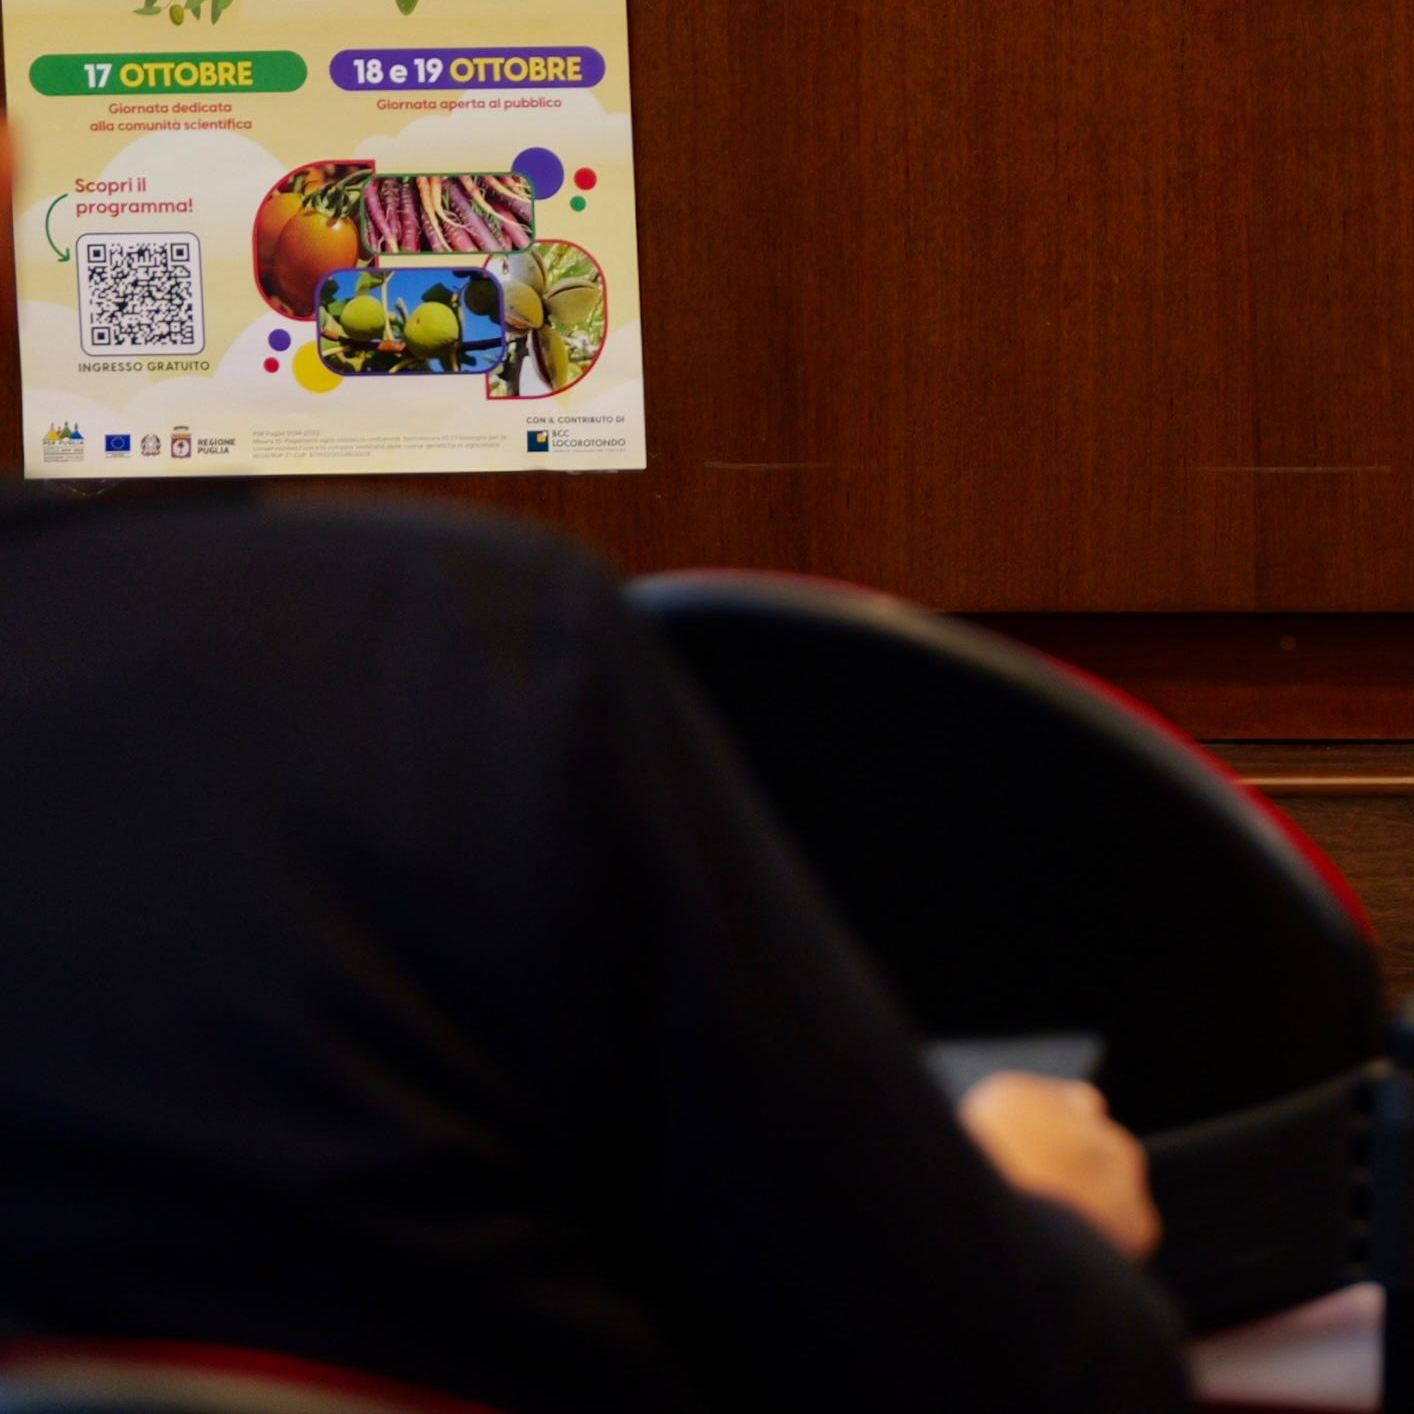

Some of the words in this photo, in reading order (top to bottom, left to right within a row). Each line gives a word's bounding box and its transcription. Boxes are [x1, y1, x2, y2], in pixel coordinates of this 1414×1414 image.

[84, 63, 112, 88] 17
[120, 61, 253, 87] OTTOBRE
[354, 58, 384, 83] 18
[389, 65, 407, 83] e
[414, 58, 443, 83] 19
[450, 57, 582, 82] OTTOBRE
[108, 103, 169, 114] Giornata
[172, 102, 232, 113] dedicata
[377, 99, 438, 110] Giornata
[440, 99, 484, 112] aperta
[488, 98, 500, 109] al
[504, 97, 562, 111] pubblico
[90, 121, 114, 131] alla
[118, 119, 181, 131] comunità
[184, 118, 252, 130] scientifica
[75, 178, 132, 197] Scopri
[136, 177, 147, 192] il
[76, 198, 193, 218] programma!
[79, 362, 143, 372] INGRESSO
[147, 361, 210, 372] GRATUITO
[198, 438, 236, 446] REGIONE
[198, 446, 230, 454] PUGLIA
